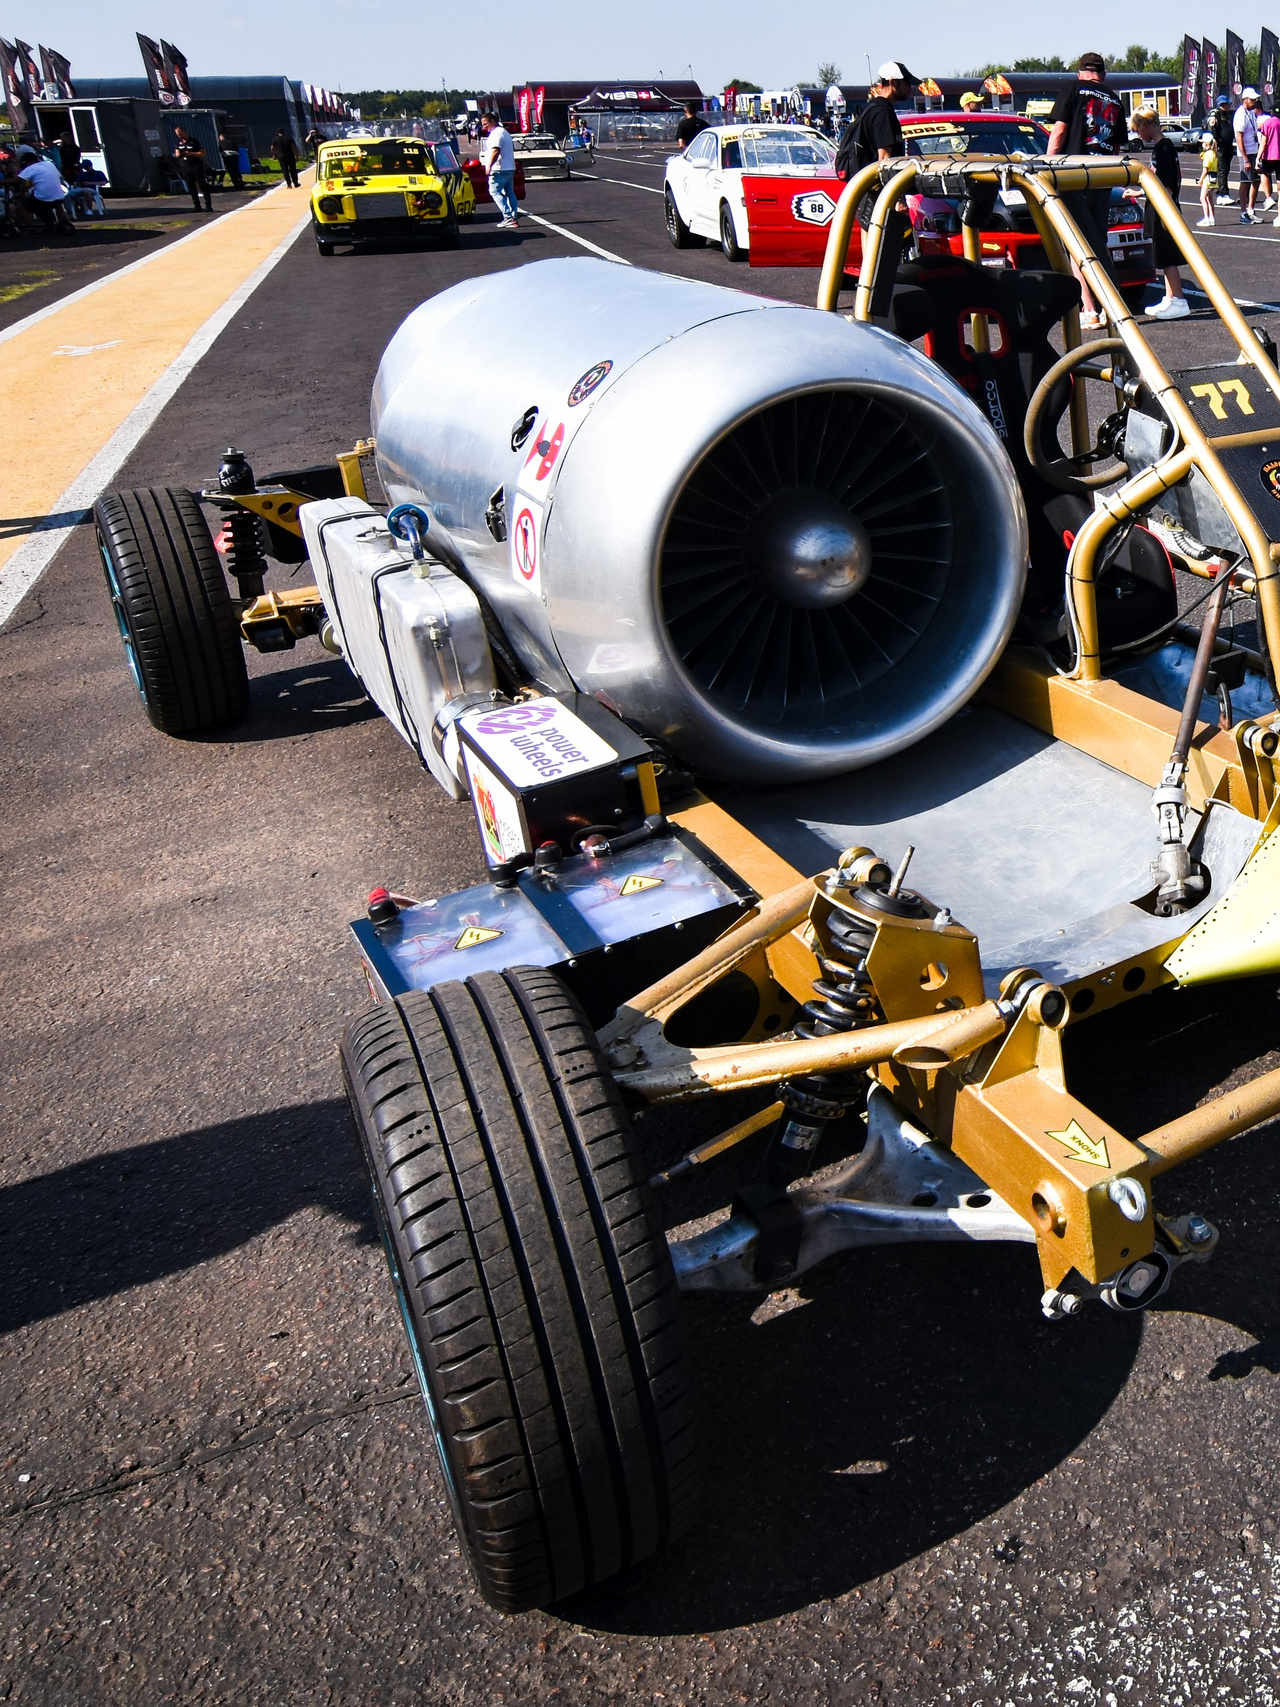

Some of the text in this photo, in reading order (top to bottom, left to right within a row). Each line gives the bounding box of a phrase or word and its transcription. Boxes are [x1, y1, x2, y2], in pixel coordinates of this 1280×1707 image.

[902, 126, 946, 136] RDRC
[326, 150, 356, 158] RDRC
[811, 204, 824, 213] 88
[986, 381, 1006, 438] sparco
[1190, 379, 1255, 420] 77
[510, 735, 563, 778] wheels
[530, 727, 589, 763] power
[1069, 1135, 1101, 1160] SHONX
